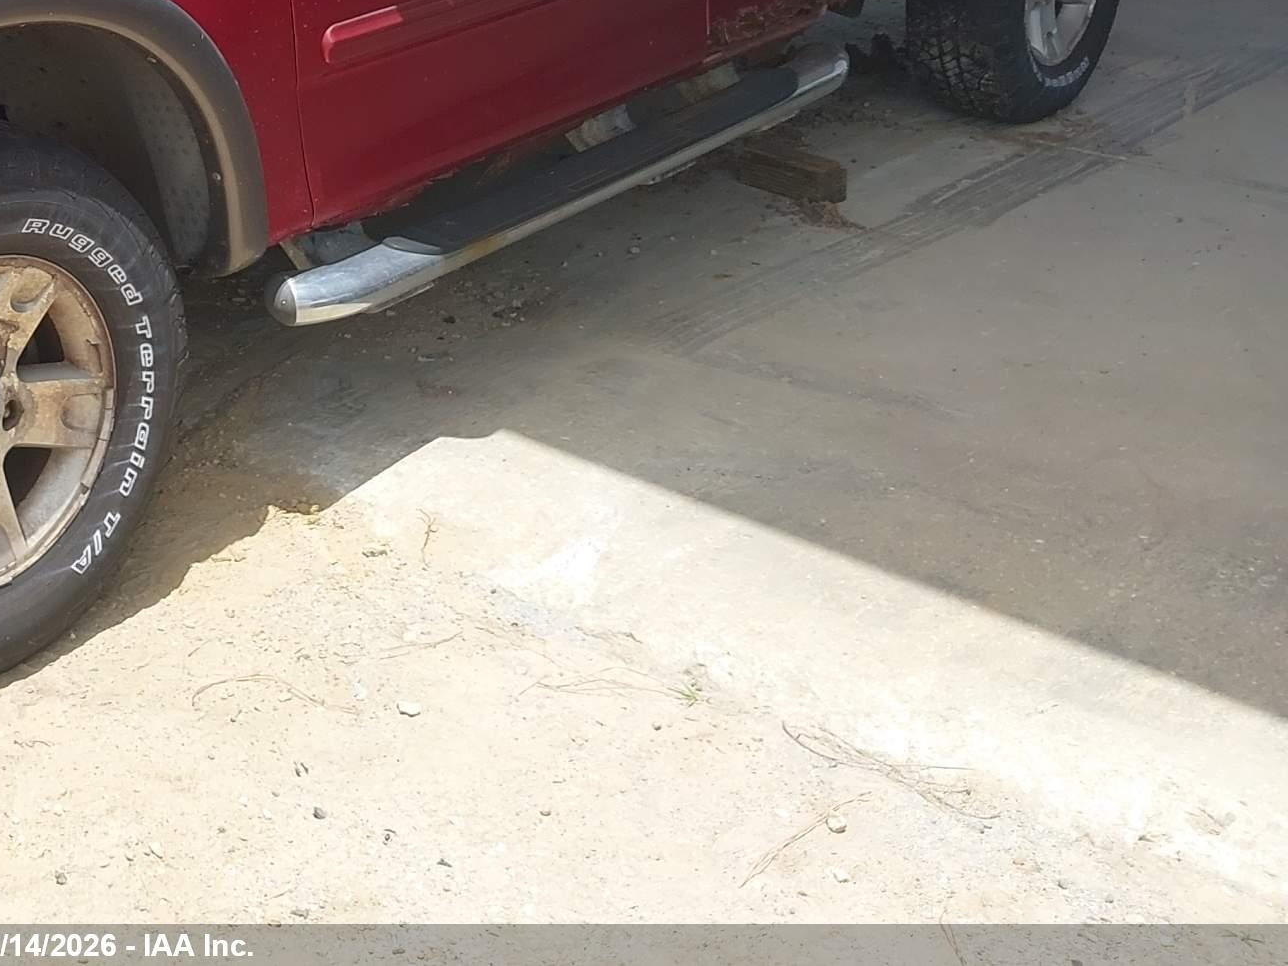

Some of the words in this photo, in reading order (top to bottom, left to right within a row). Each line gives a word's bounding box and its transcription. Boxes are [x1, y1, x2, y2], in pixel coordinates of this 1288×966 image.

[21, 217, 144, 307] Rugged
[118, 315, 156, 497] Terrain
[70, 511, 123, 576] T/A
